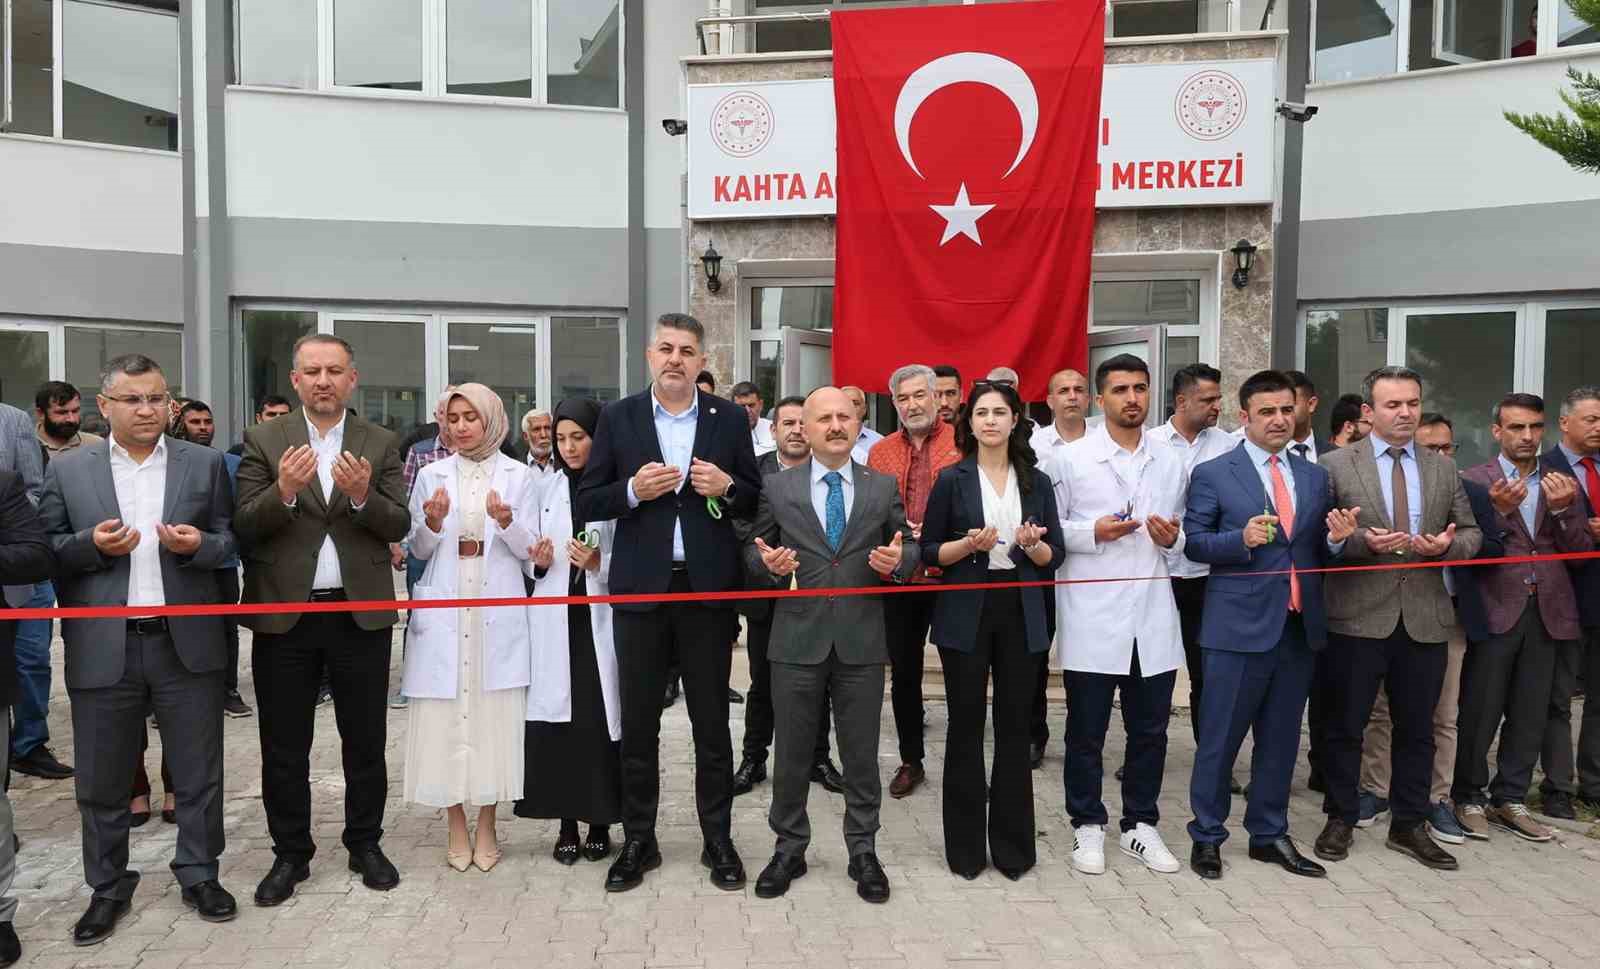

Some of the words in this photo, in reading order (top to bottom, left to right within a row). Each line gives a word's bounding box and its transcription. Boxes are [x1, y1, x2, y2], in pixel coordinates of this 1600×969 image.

[714, 173, 807, 201] KAHTA
[814, 171, 833, 198] A
[1112, 153, 1243, 189] MERKEZİ
